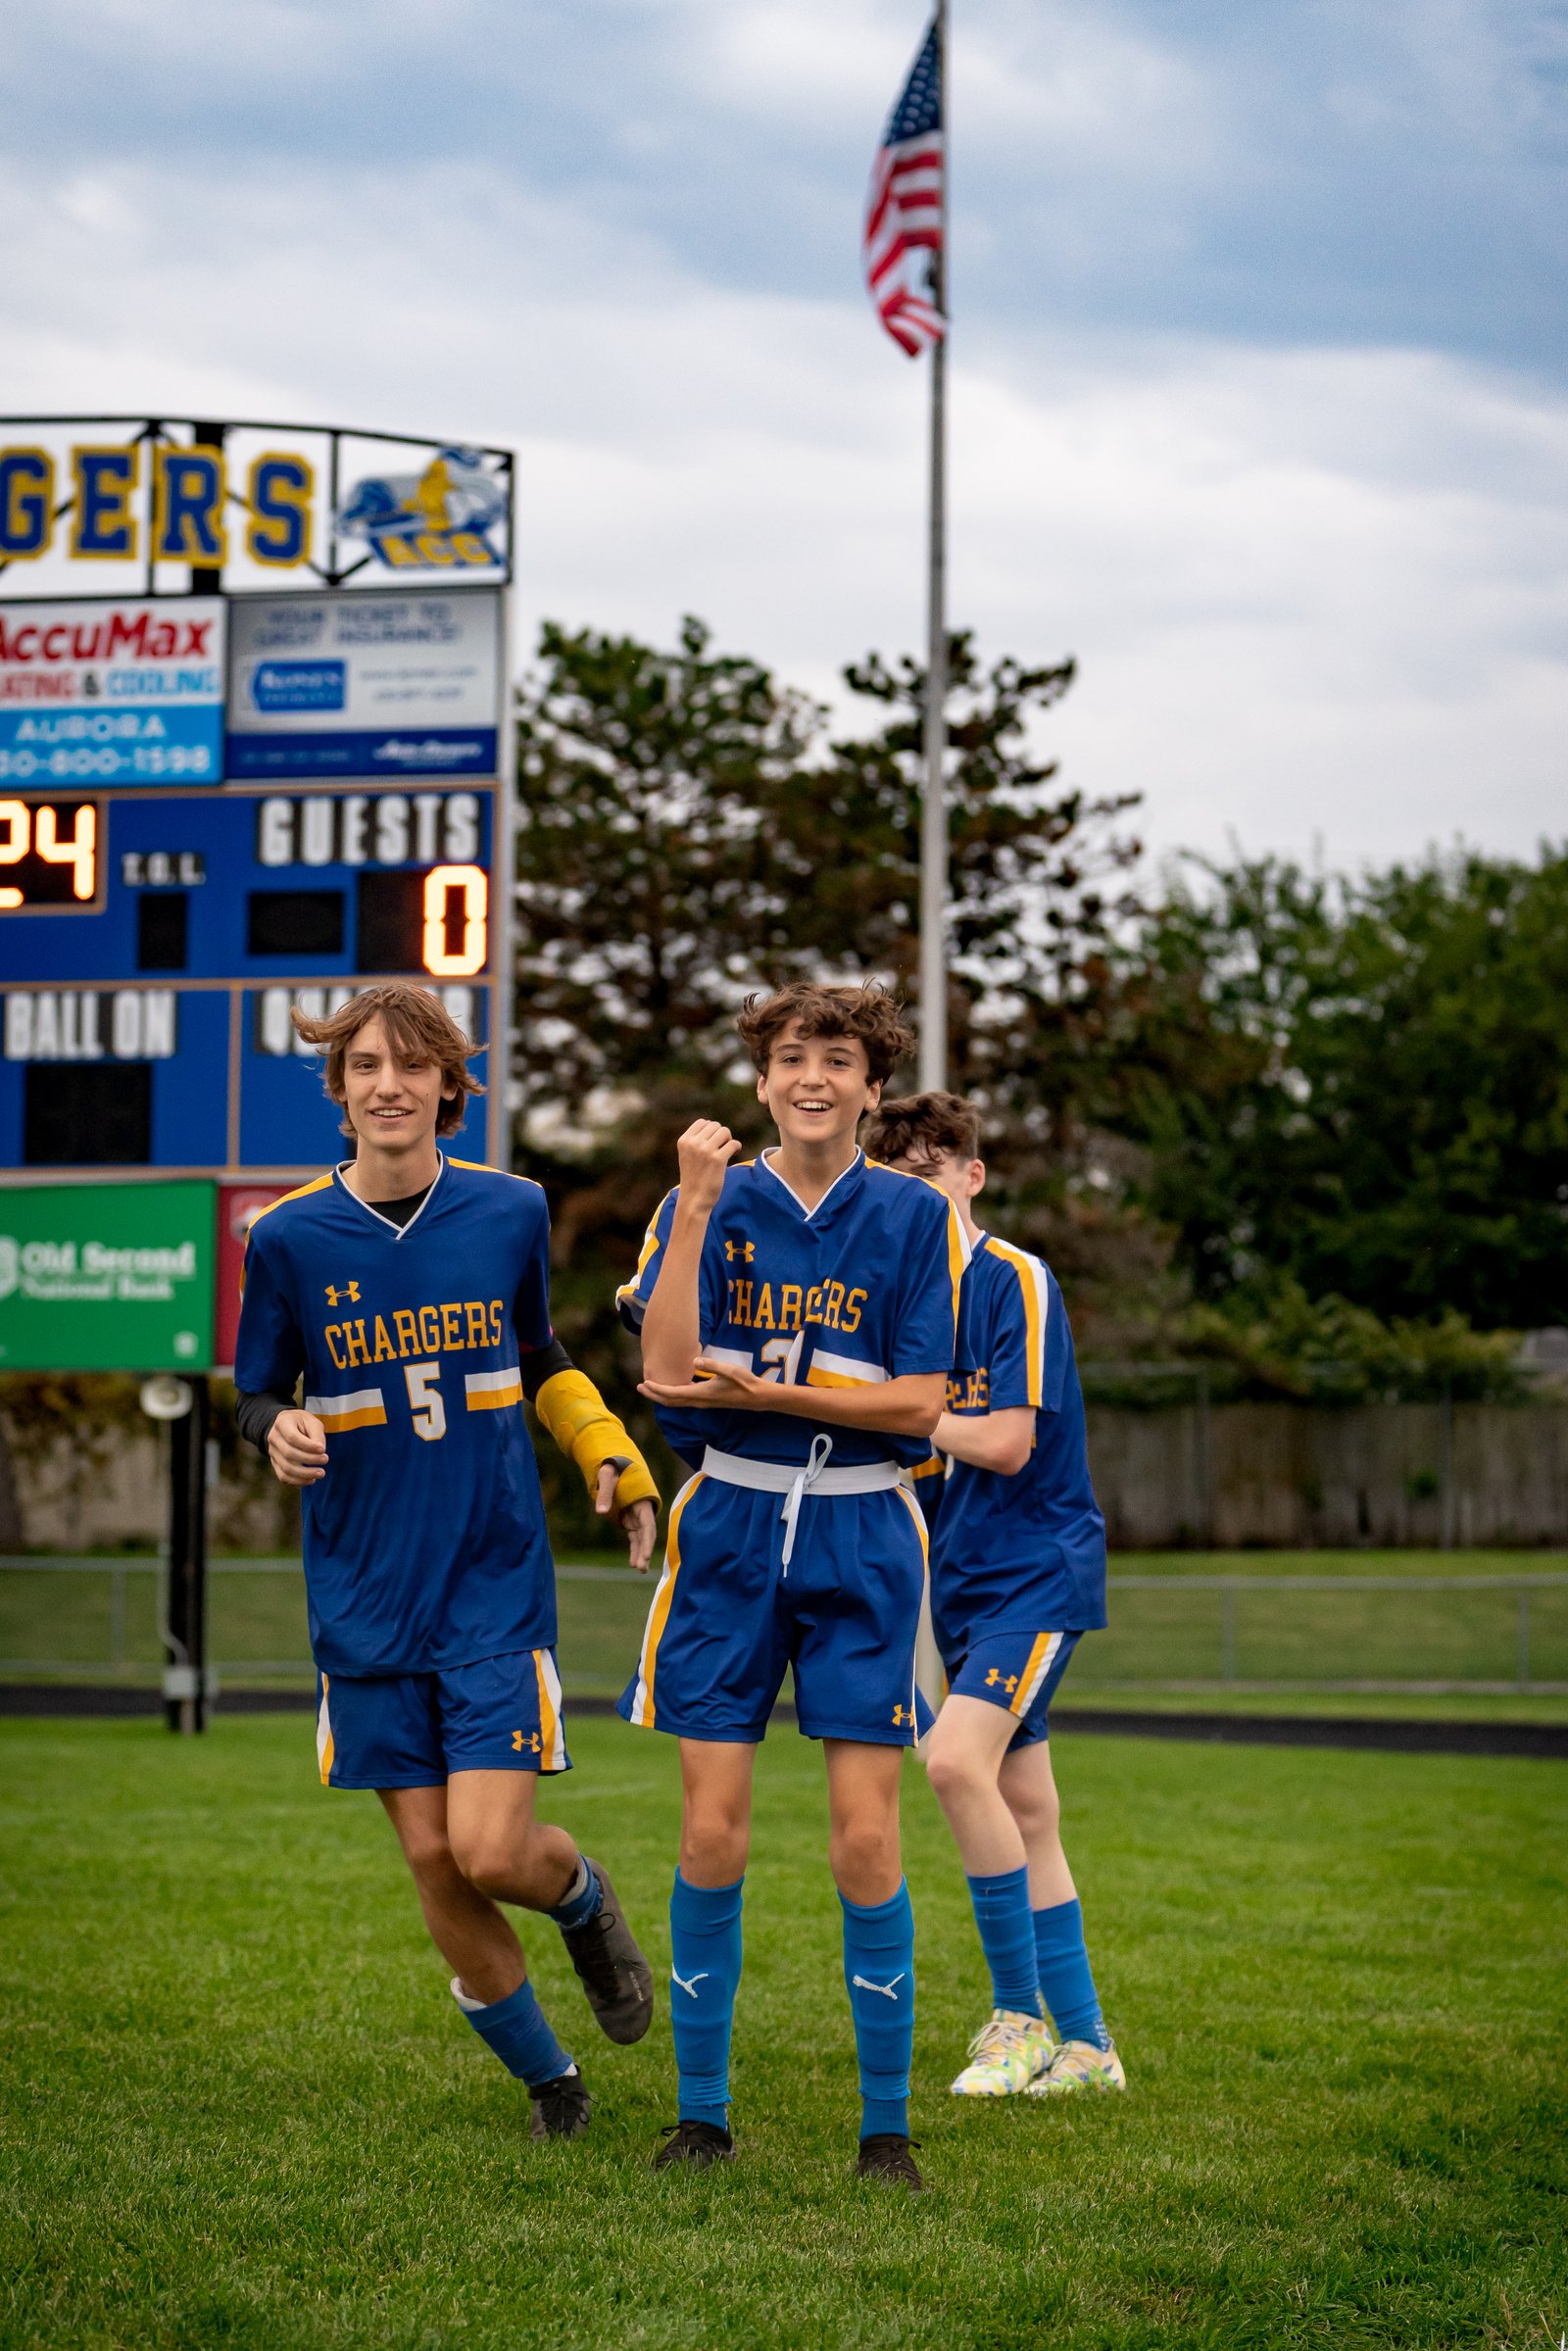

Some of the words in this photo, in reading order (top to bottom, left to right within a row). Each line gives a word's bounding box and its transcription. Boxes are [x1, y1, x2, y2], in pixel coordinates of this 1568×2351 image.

[0, 445, 314, 568] GERS
[106, 668, 219, 698] COOLING
[15, 713, 167, 743] AURORA
[259, 795, 479, 866] GUESTS
[421, 863, 488, 977] 0
[4, 991, 105, 1061] BALL
[112, 989, 176, 1060] ON
[22, 1241, 76, 1275] Old
[82, 1241, 196, 1279] Second
[324, 1299, 504, 1370] CHARGERS
[728, 1278, 868, 1333] HARRS
[404, 1361, 447, 1442] 5
